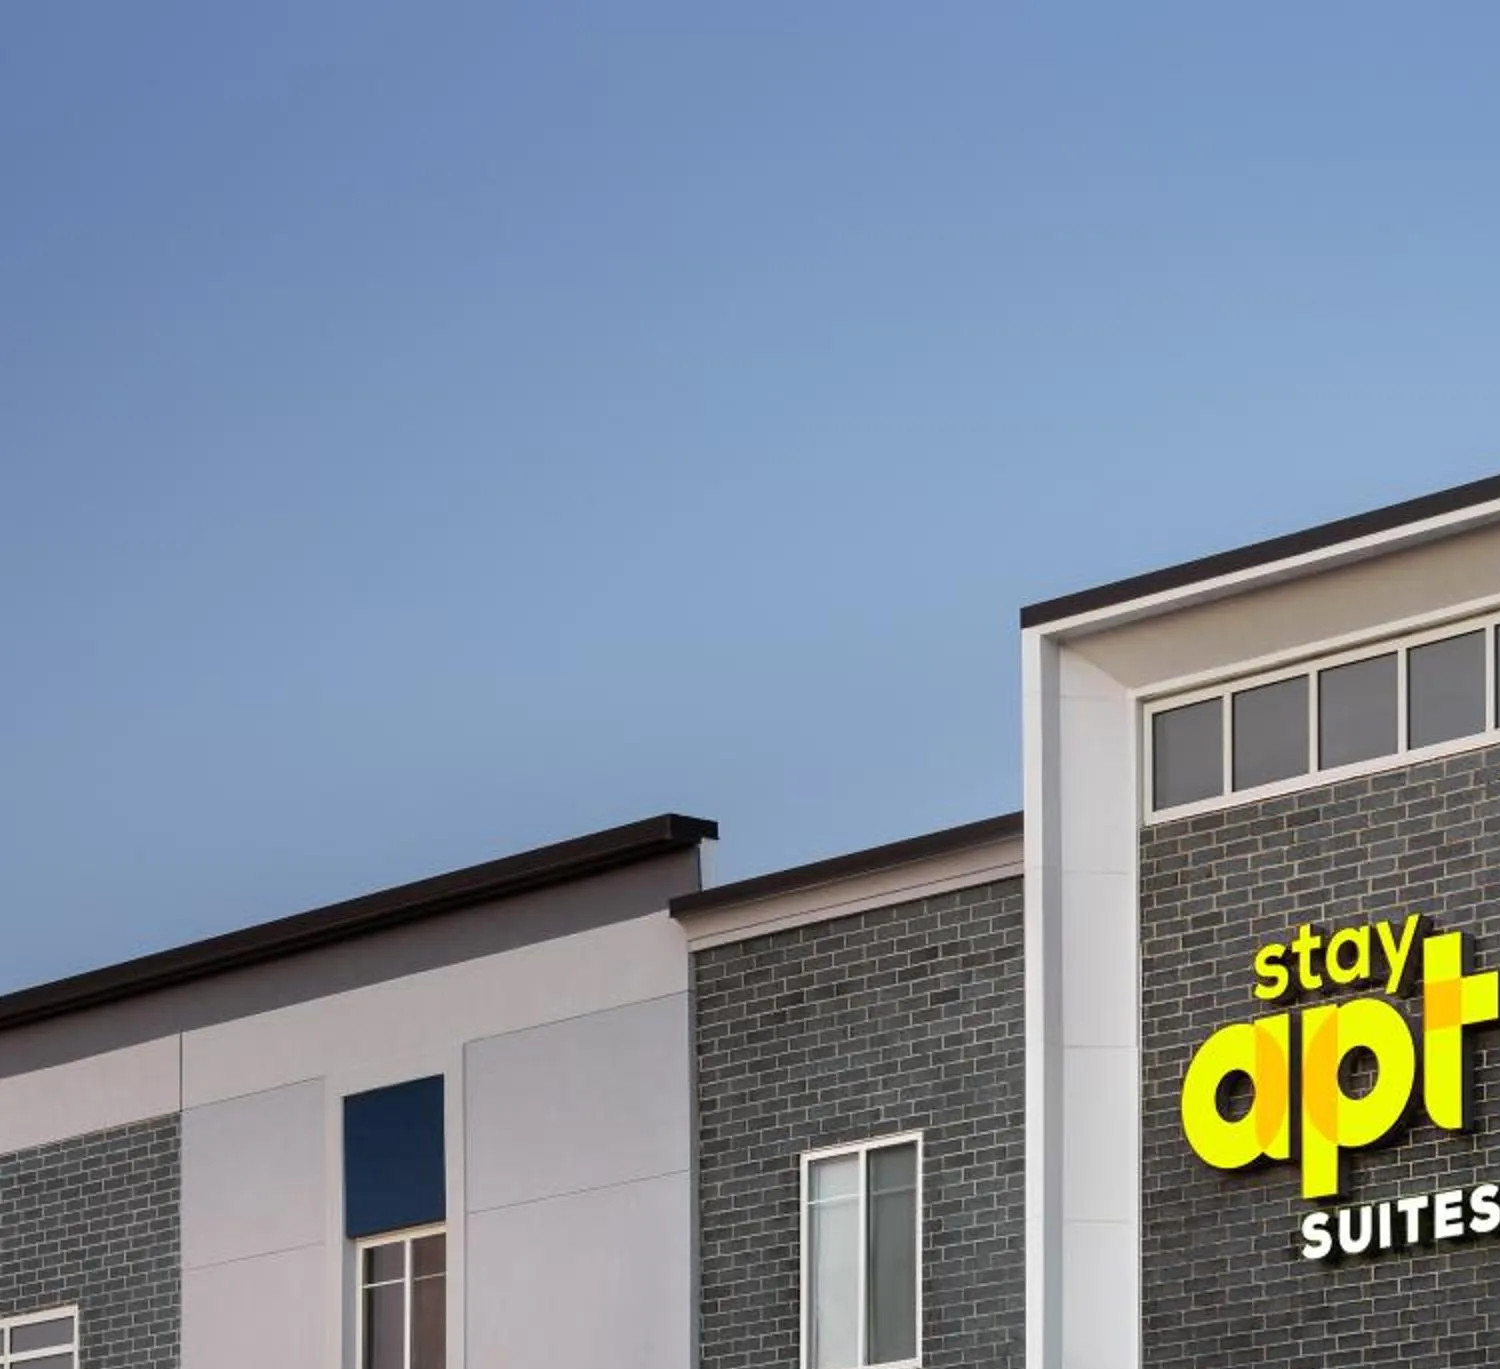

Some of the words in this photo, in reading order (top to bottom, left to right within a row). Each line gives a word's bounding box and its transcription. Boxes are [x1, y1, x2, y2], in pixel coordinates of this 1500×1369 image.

[1254, 913, 1421, 999] stay
[1181, 931, 1499, 1199] apt
[1301, 1184, 1500, 1260] SUITES
